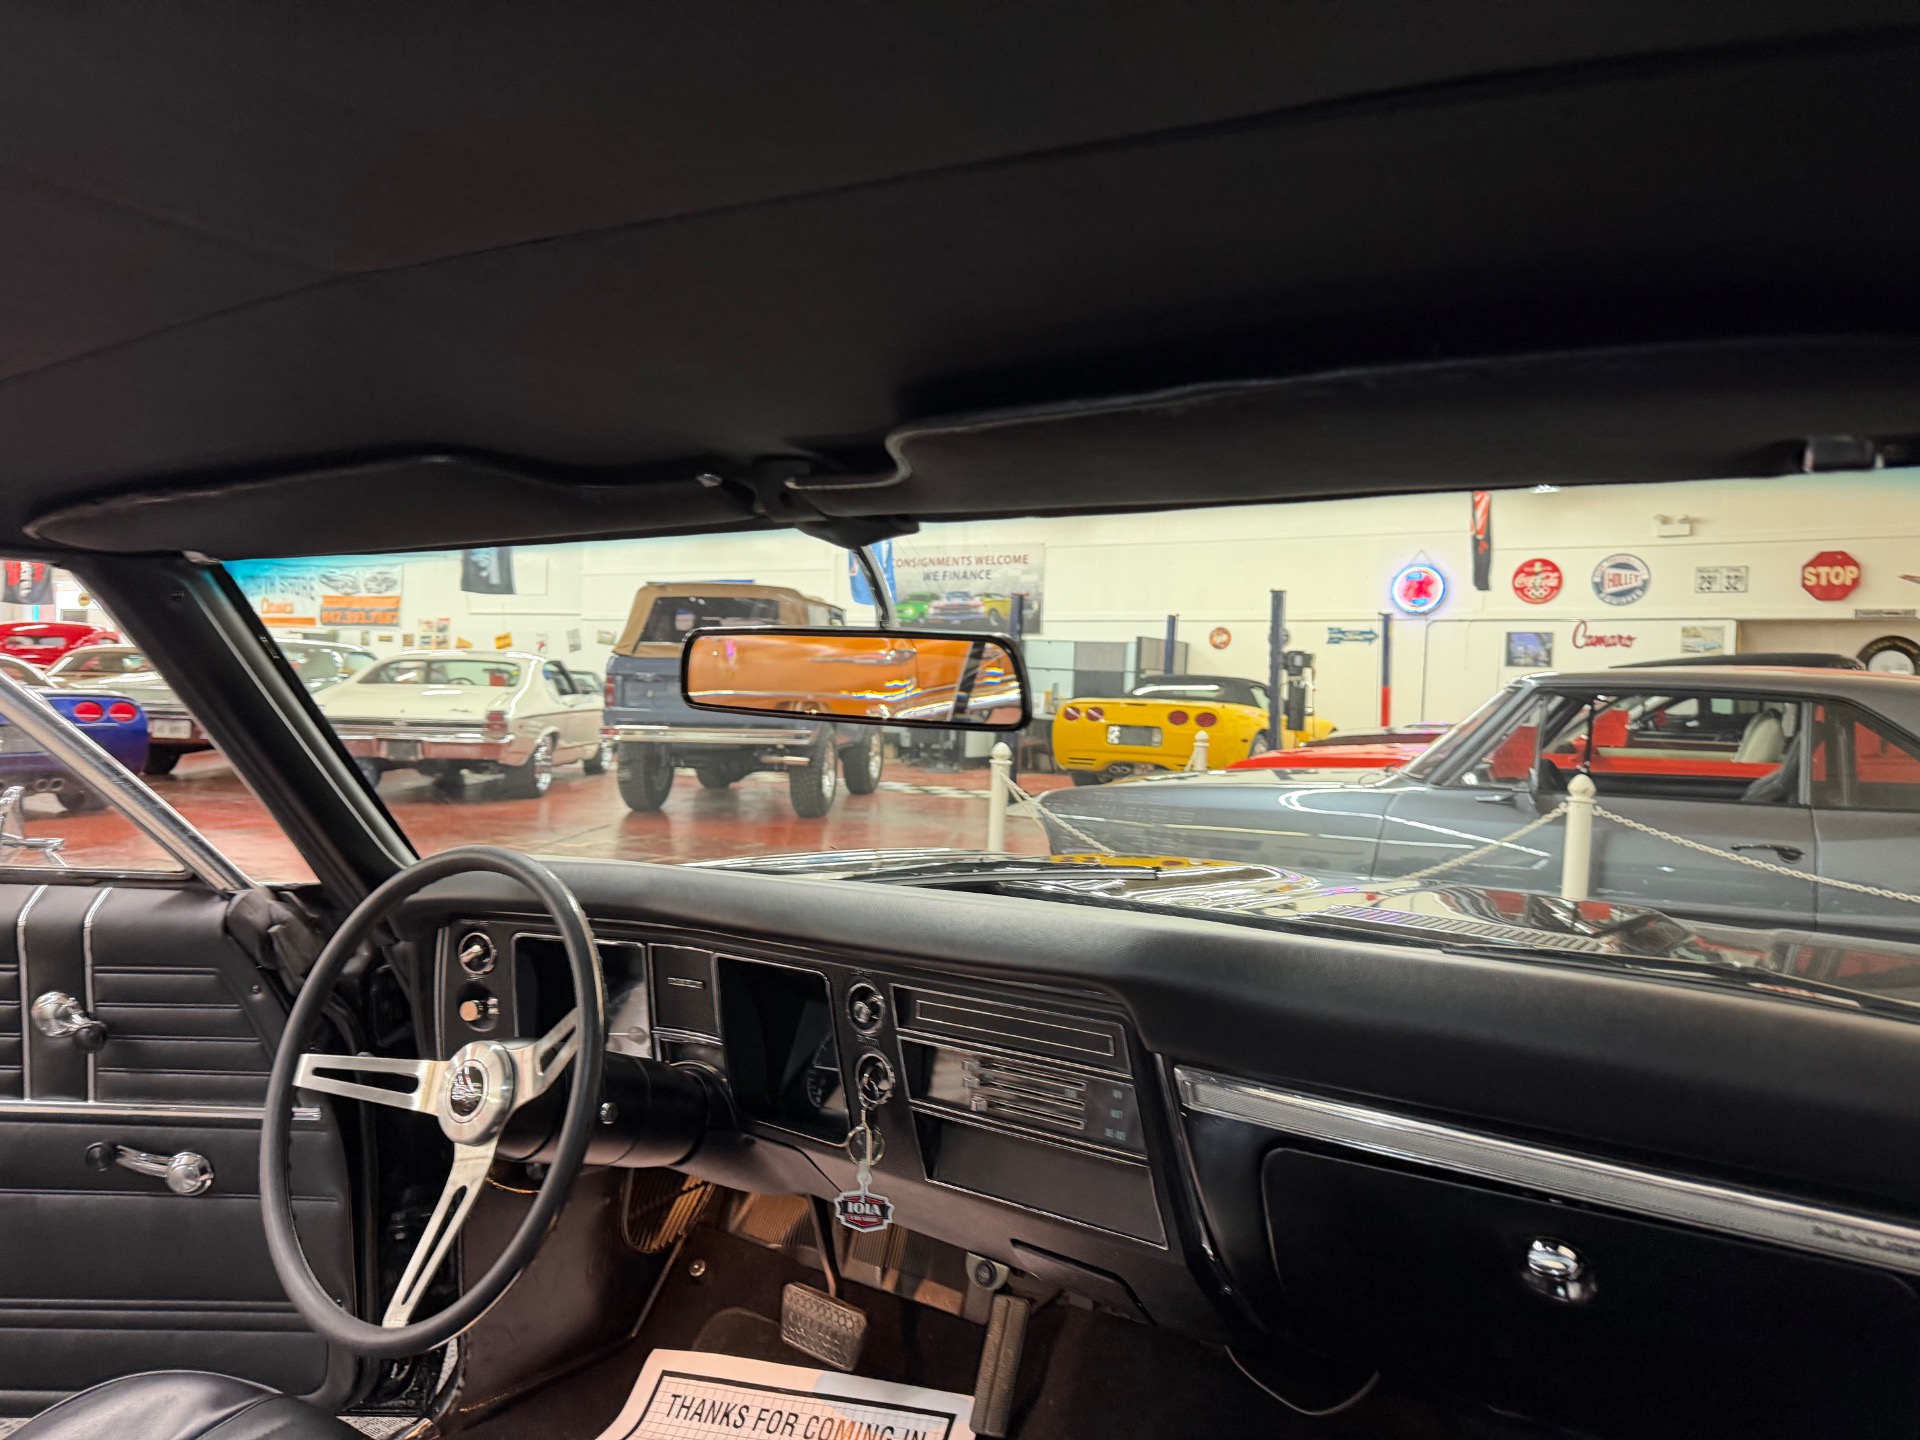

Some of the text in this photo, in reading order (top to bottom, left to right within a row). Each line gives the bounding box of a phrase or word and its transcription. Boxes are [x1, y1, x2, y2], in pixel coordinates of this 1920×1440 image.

[974, 554, 1029, 566] WELCOME
[922, 569, 992, 582] WE FINANCE
[1607, 572, 1640, 589] HOLLEY
[1803, 565, 1859, 587] STOP
[1571, 619, 1637, 649] Camaro
[847, 1201, 882, 1216] IOLA
[666, 1393, 750, 1430] THANKS
[752, 1408, 799, 1438] FOR
[803, 1415, 894, 1440] COMING
